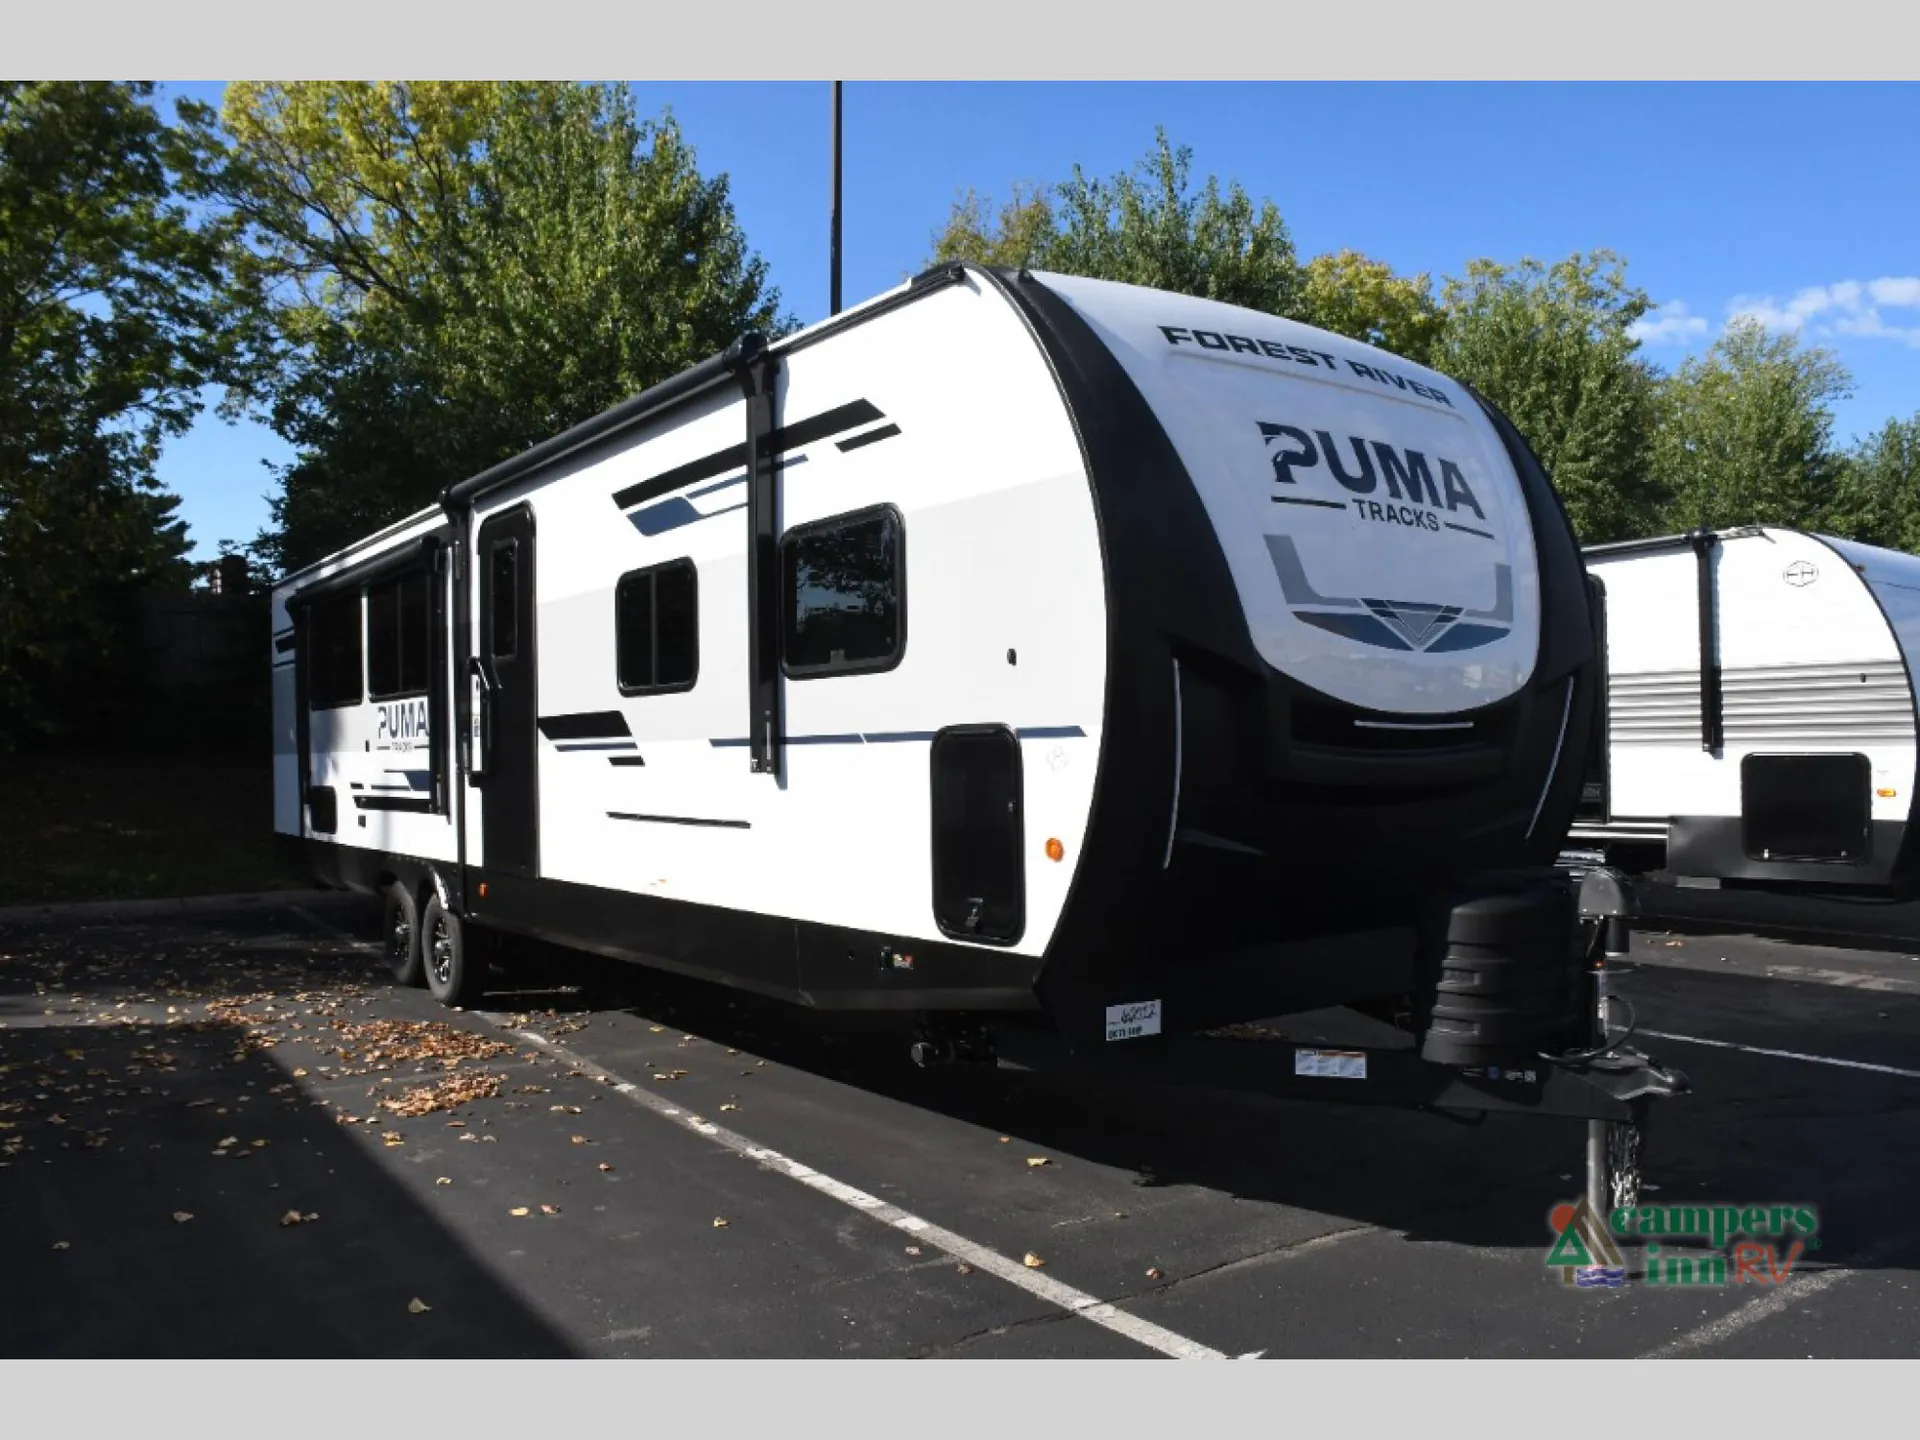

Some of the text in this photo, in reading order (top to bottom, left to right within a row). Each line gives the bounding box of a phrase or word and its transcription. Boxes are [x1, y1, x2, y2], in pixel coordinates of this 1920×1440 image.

[1157, 325, 1456, 409] FOREST RIVER
[1255, 421, 1486, 520] PUMA
[1352, 499, 1441, 532] TRACKS
[377, 701, 430, 740] PUMA
